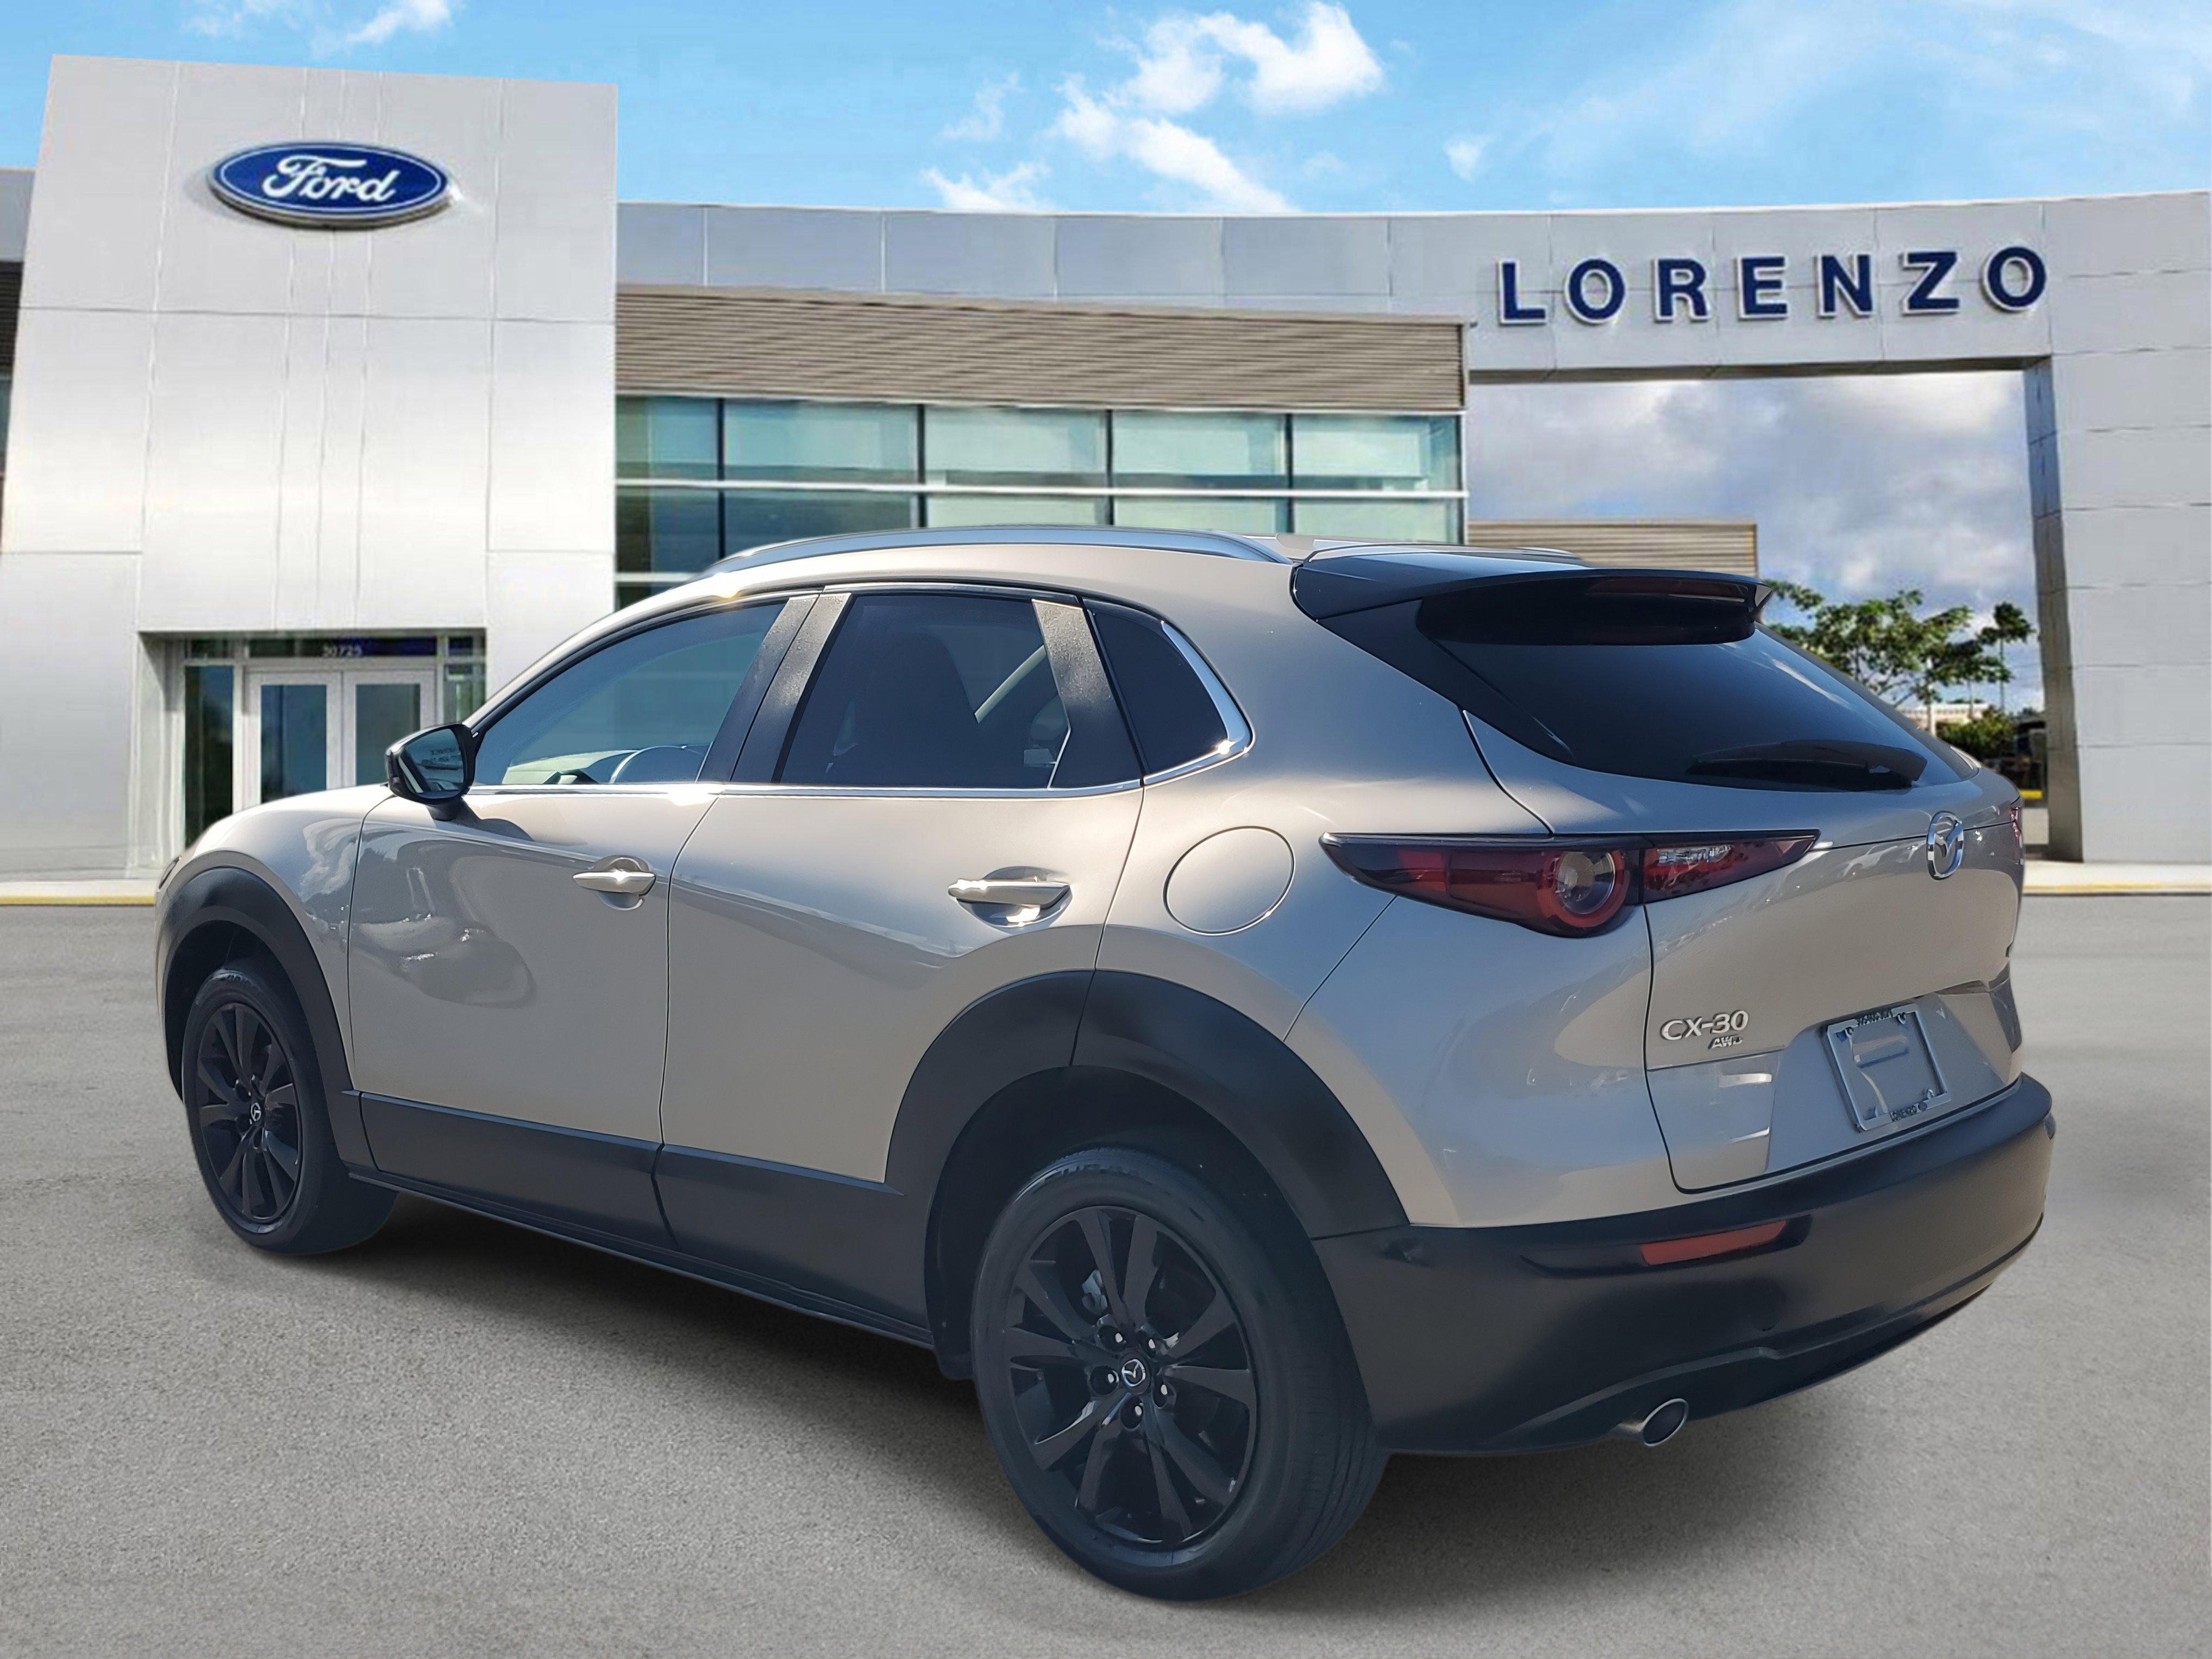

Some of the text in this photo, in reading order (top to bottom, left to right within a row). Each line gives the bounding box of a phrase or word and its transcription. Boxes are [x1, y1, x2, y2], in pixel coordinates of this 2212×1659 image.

[262, 154, 400, 202] Ford
[1498, 246, 2048, 323] LORENZO
[1660, 1009, 1749, 1041] CX-30
